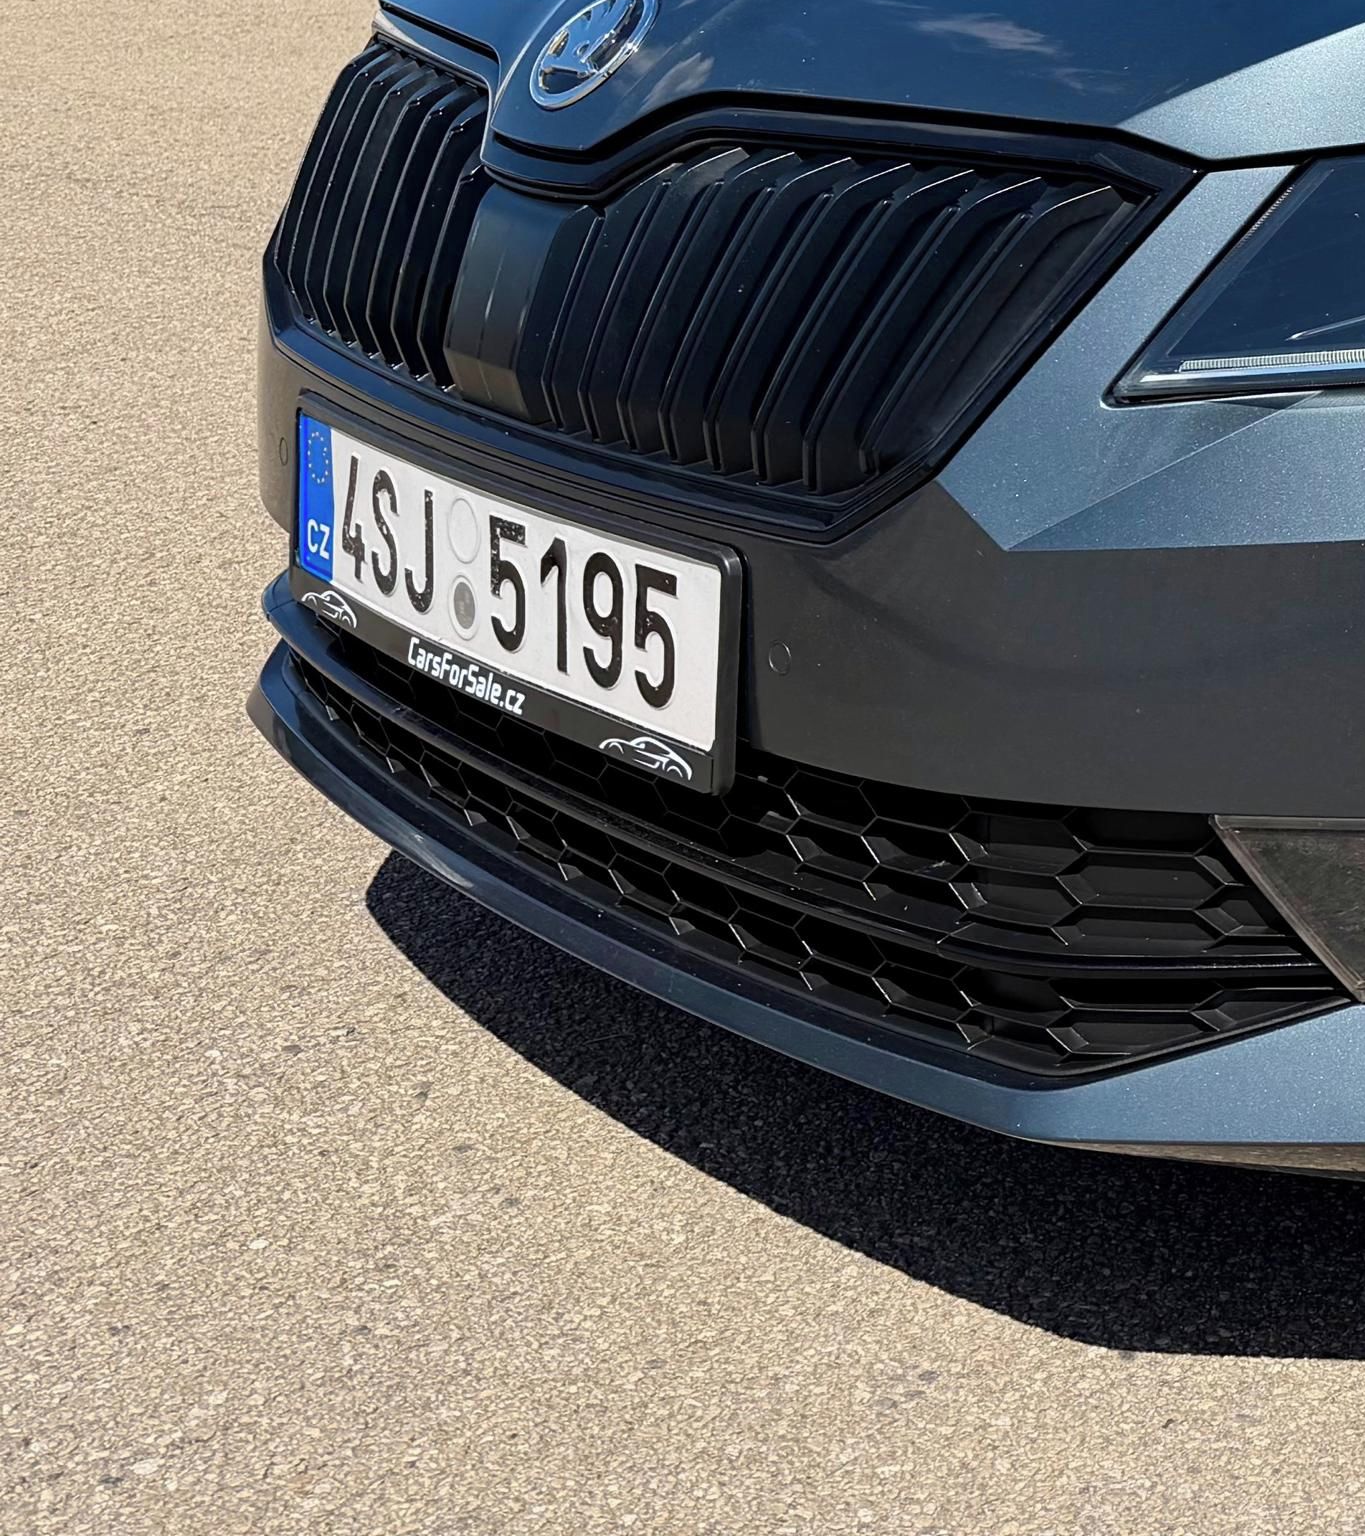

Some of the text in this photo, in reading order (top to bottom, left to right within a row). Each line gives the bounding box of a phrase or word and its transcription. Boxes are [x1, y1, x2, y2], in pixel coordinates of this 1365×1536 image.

[307, 518, 330, 560] CZ
[341, 455, 677, 709] 4SJ 5195
[407, 636, 526, 715] CarsForSale.cz
